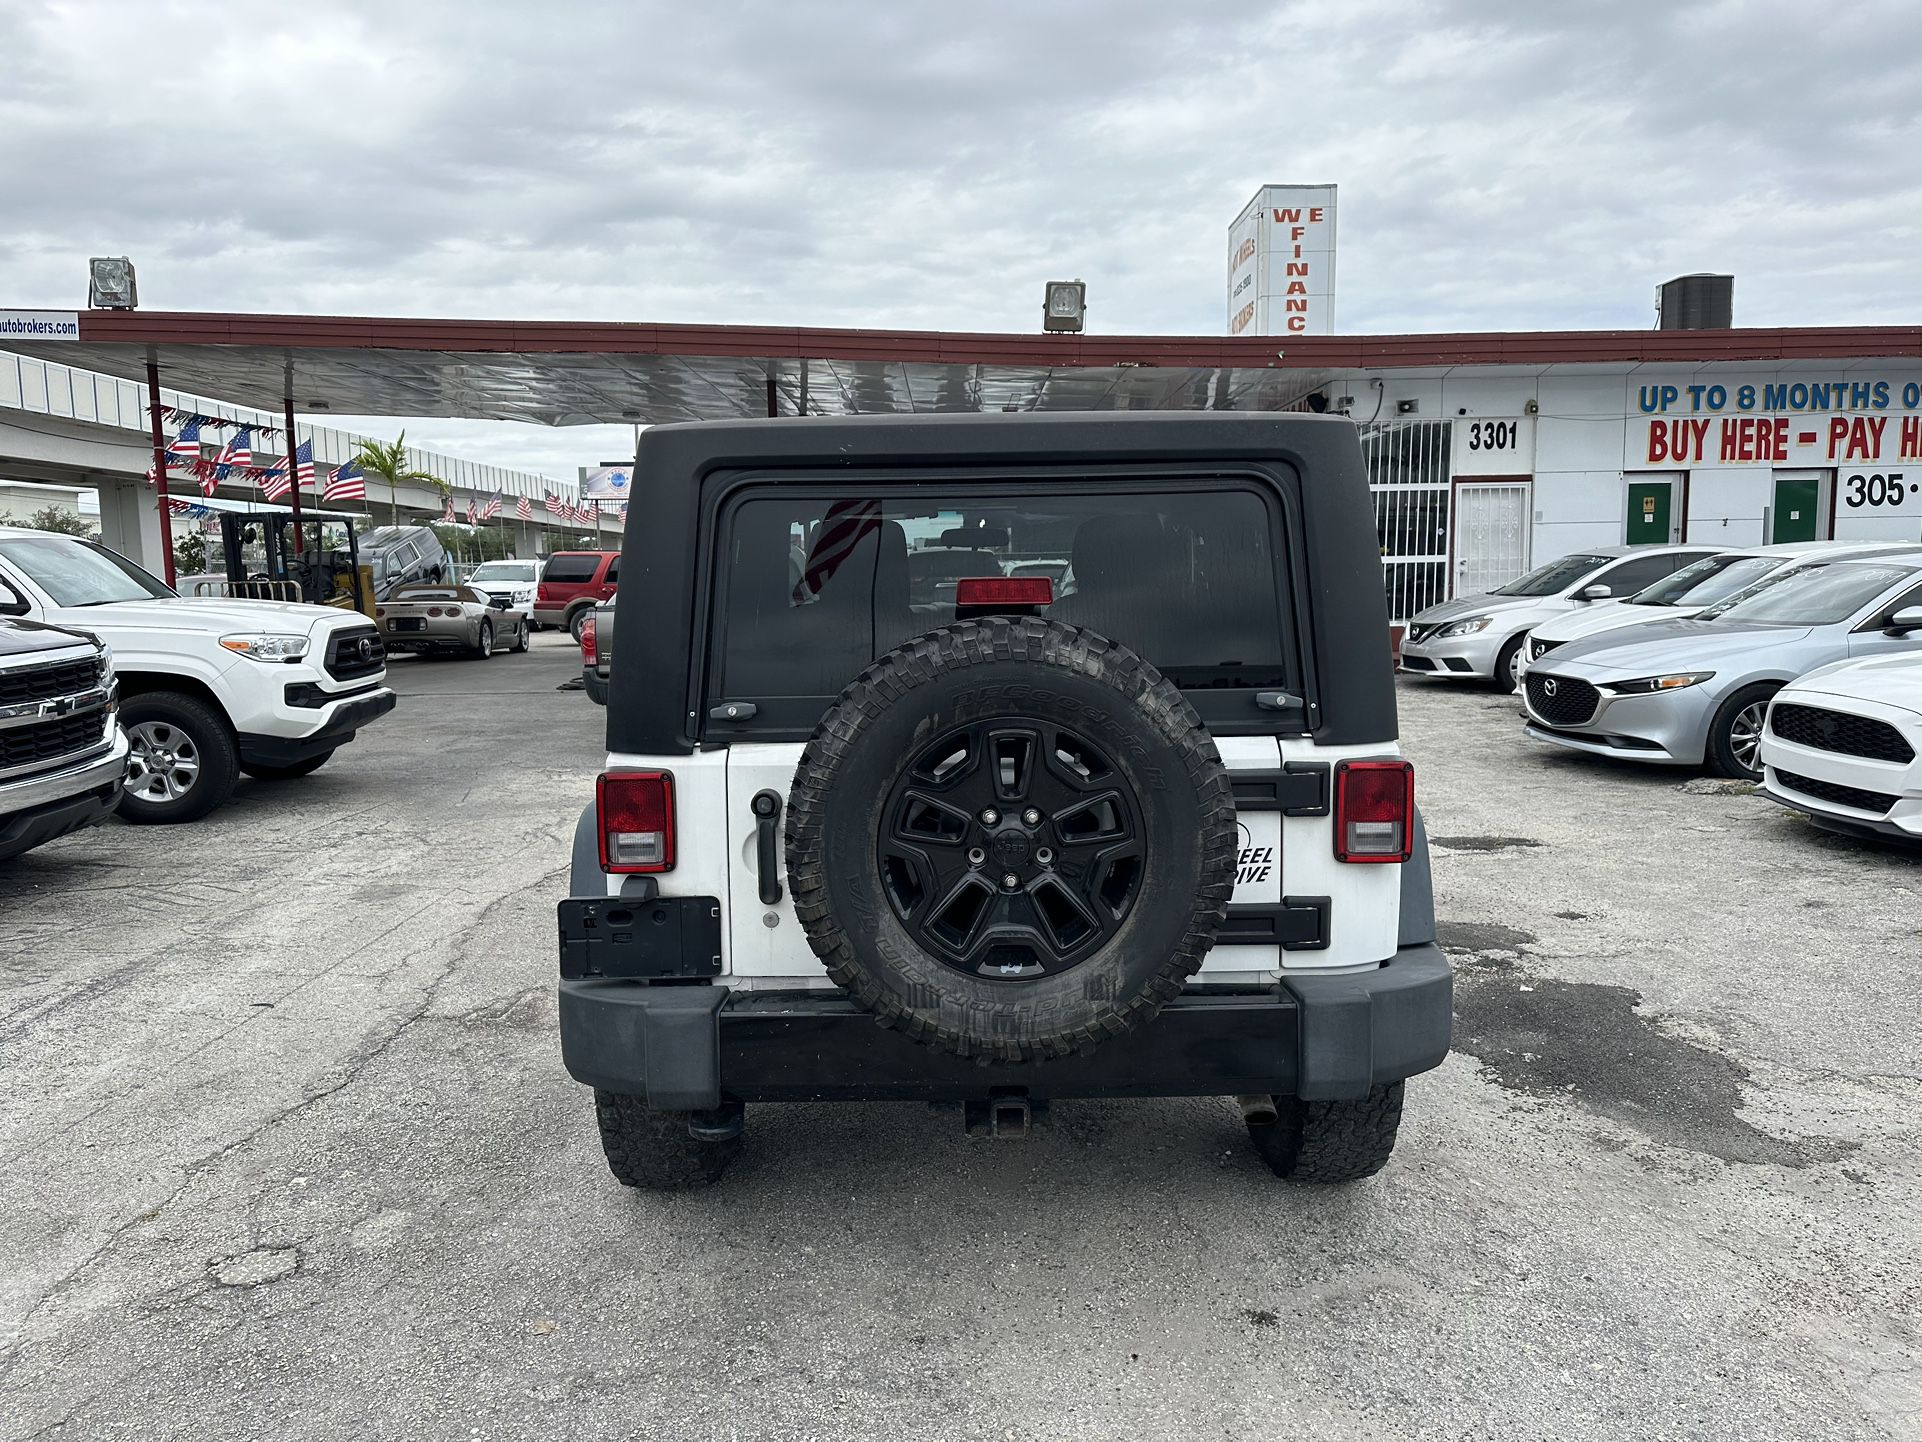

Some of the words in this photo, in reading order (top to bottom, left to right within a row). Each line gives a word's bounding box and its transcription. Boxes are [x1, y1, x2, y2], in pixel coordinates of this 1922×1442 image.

[1286, 227, 1309, 336] FINANC
[1638, 384, 1678, 412] UP
[1688, 383, 1727, 410] TO
[1737, 384, 1756, 410] 8
[1763, 381, 1890, 411] MONTHS
[1469, 421, 1517, 450] 3301
[1648, 418, 1711, 462] BUY
[1719, 417, 1790, 463] HERE
[1826, 416, 1888, 461] PAY
[1236, 847, 1273, 865] EEL
